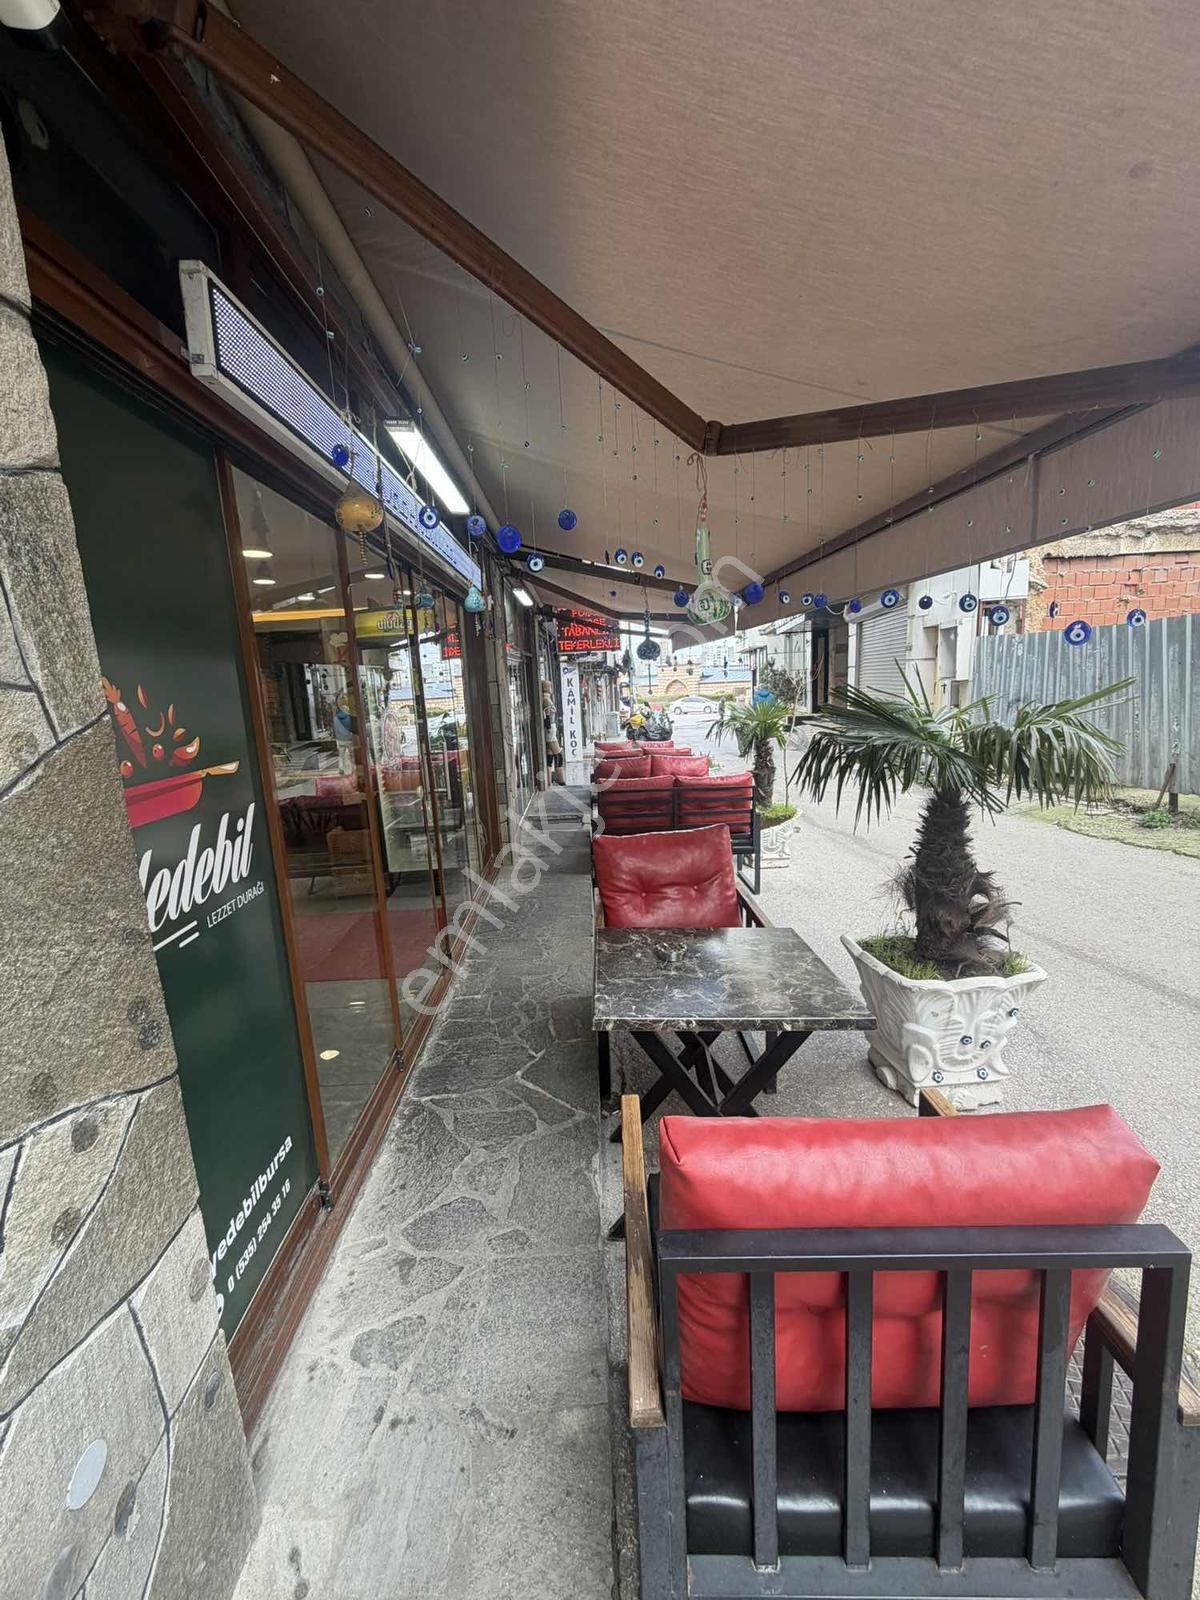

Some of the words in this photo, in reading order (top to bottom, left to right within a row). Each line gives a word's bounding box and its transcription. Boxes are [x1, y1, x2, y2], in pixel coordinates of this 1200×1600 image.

[207, 898, 237, 928] LEZZET
[237, 881, 265, 909] DURAĞI
[227, 1274, 235, 1294] 0
[235, 1236, 258, 1280] (535)
[256, 1211, 272, 1243] 254
[271, 1193, 282, 1217] 35
[281, 1178, 292, 1199] 16
